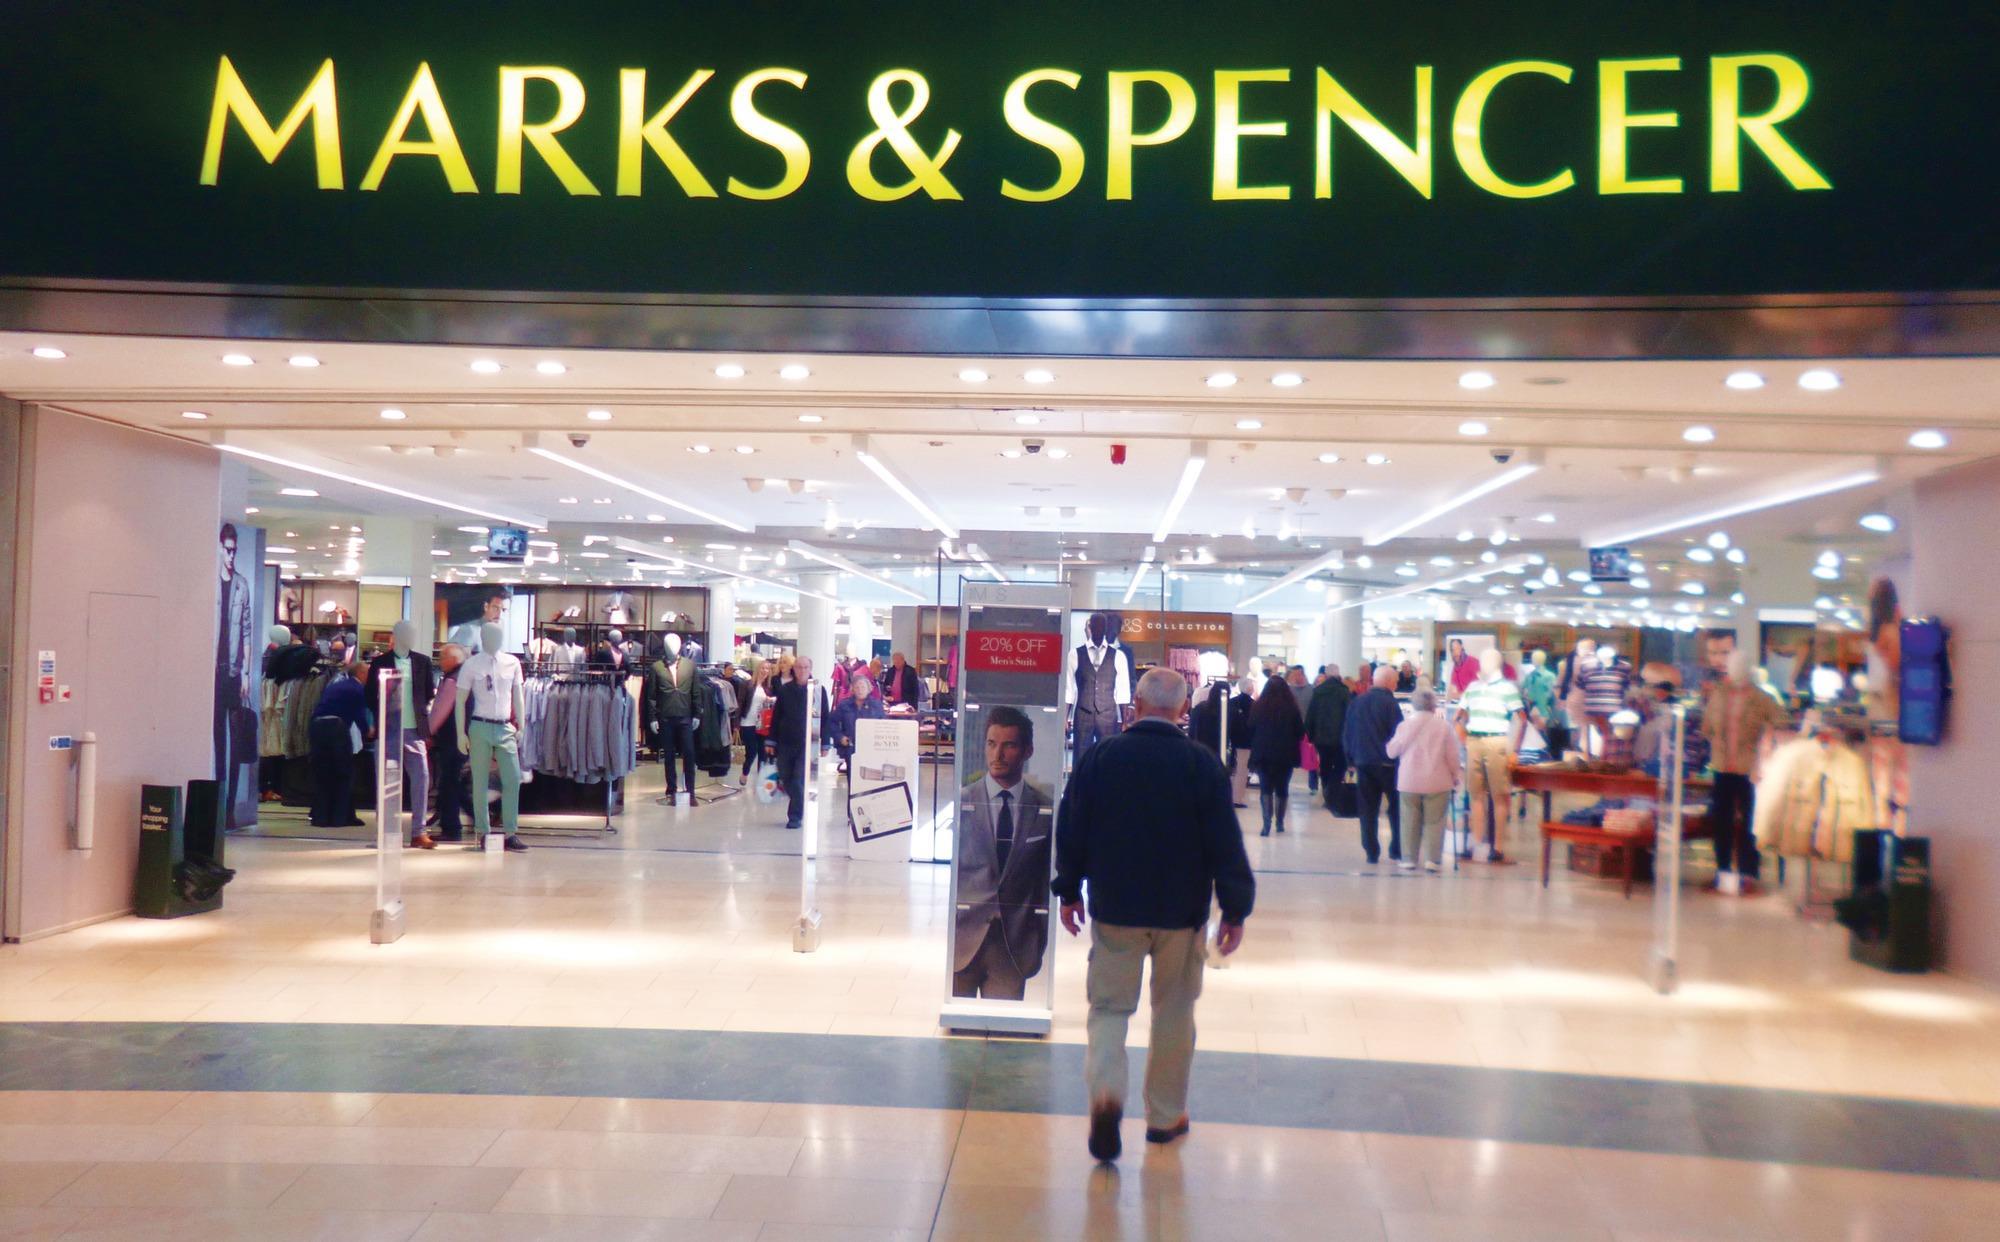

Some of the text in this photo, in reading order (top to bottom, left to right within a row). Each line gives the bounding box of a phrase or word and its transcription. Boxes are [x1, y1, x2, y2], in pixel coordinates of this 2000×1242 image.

[200, 54, 1832, 202] MARKS & SPENCER
[1147, 622, 1225, 631] COLLECTION
[980, 636, 1048, 653] 20% OFF
[990, 655, 1037, 667] Men's Suits
